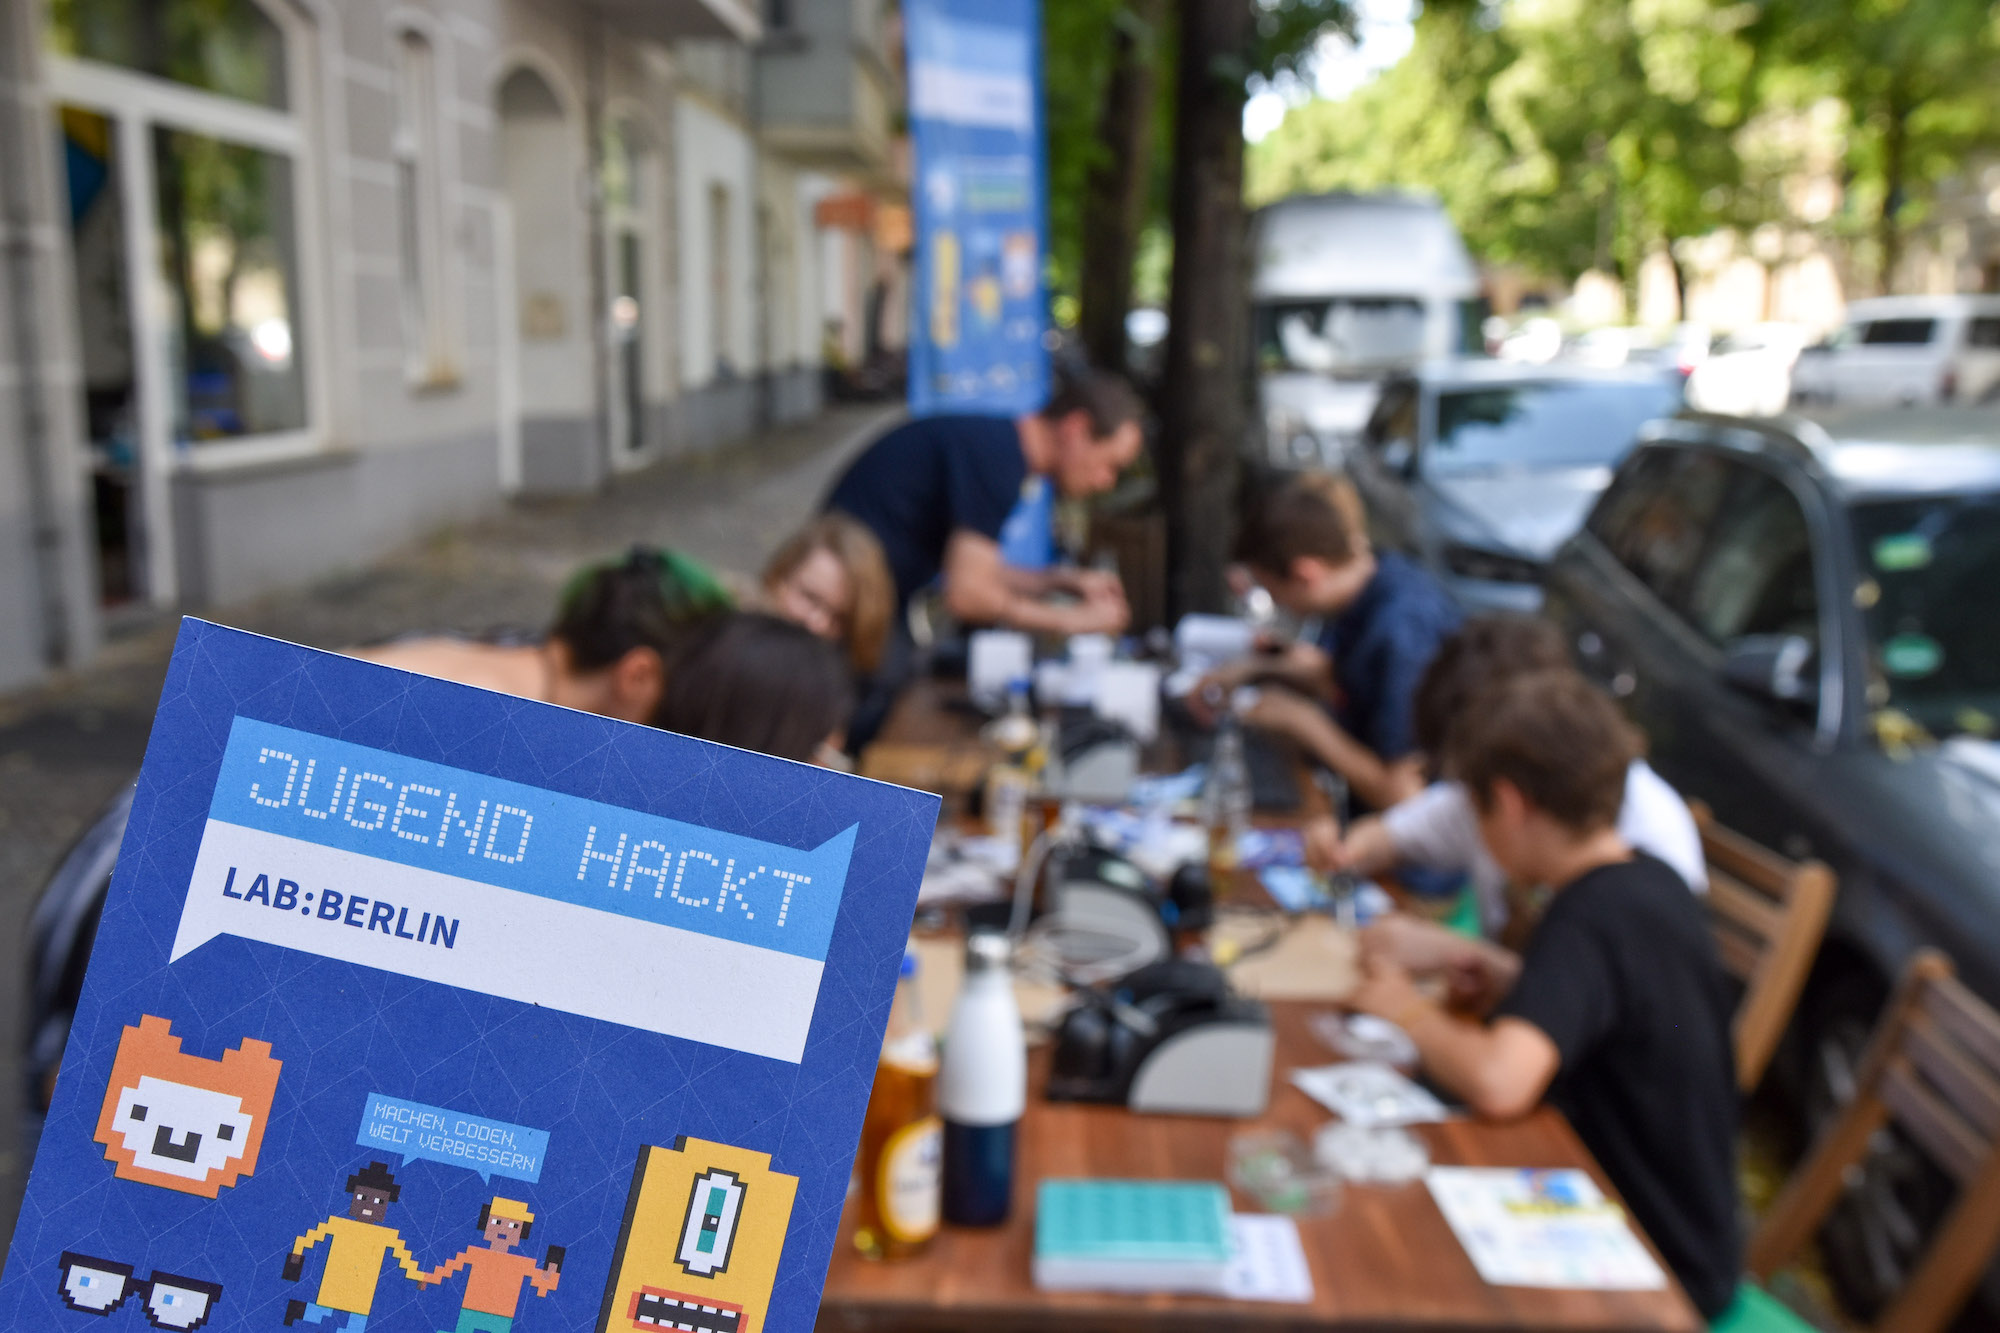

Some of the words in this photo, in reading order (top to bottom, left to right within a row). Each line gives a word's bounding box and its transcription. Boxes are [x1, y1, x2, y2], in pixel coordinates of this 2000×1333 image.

[250, 748, 533, 864] JUGEND
[577, 826, 811, 927] HACKT
[222, 866, 460, 950] LAB:BERLIN
[369, 1122, 413, 1144] WELT
[419, 1133, 536, 1172] VERBESSERN
[373, 1102, 448, 1136] MACHEN,
[454, 1120, 517, 1151] CODEN,
